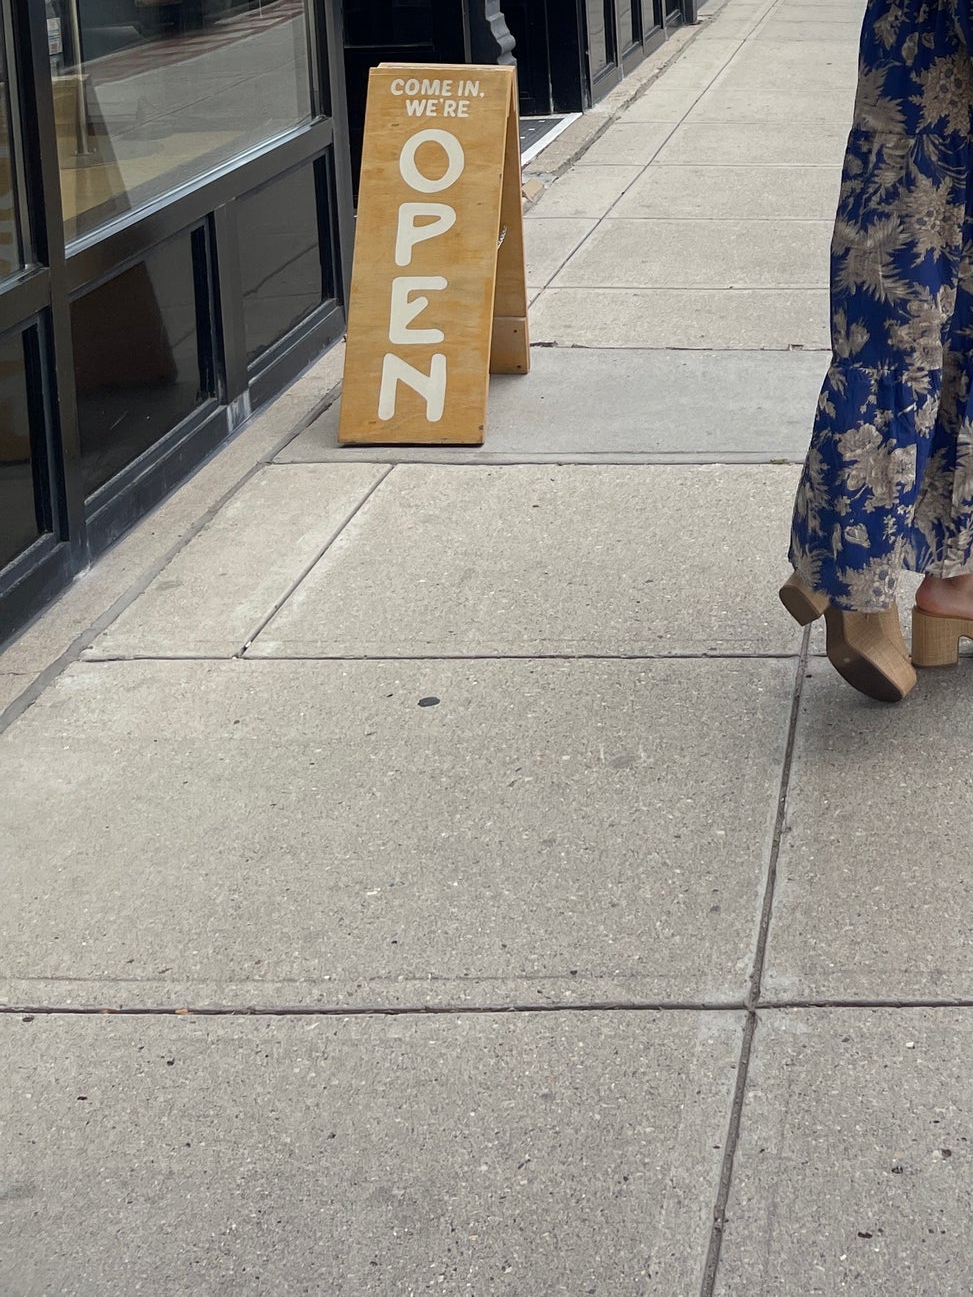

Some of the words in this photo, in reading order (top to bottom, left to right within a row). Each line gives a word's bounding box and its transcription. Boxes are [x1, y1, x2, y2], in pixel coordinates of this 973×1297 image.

[390, 78, 453, 97] COME
[405, 98, 471, 118] WE'RE
[377, 128, 465, 422] OPEN
